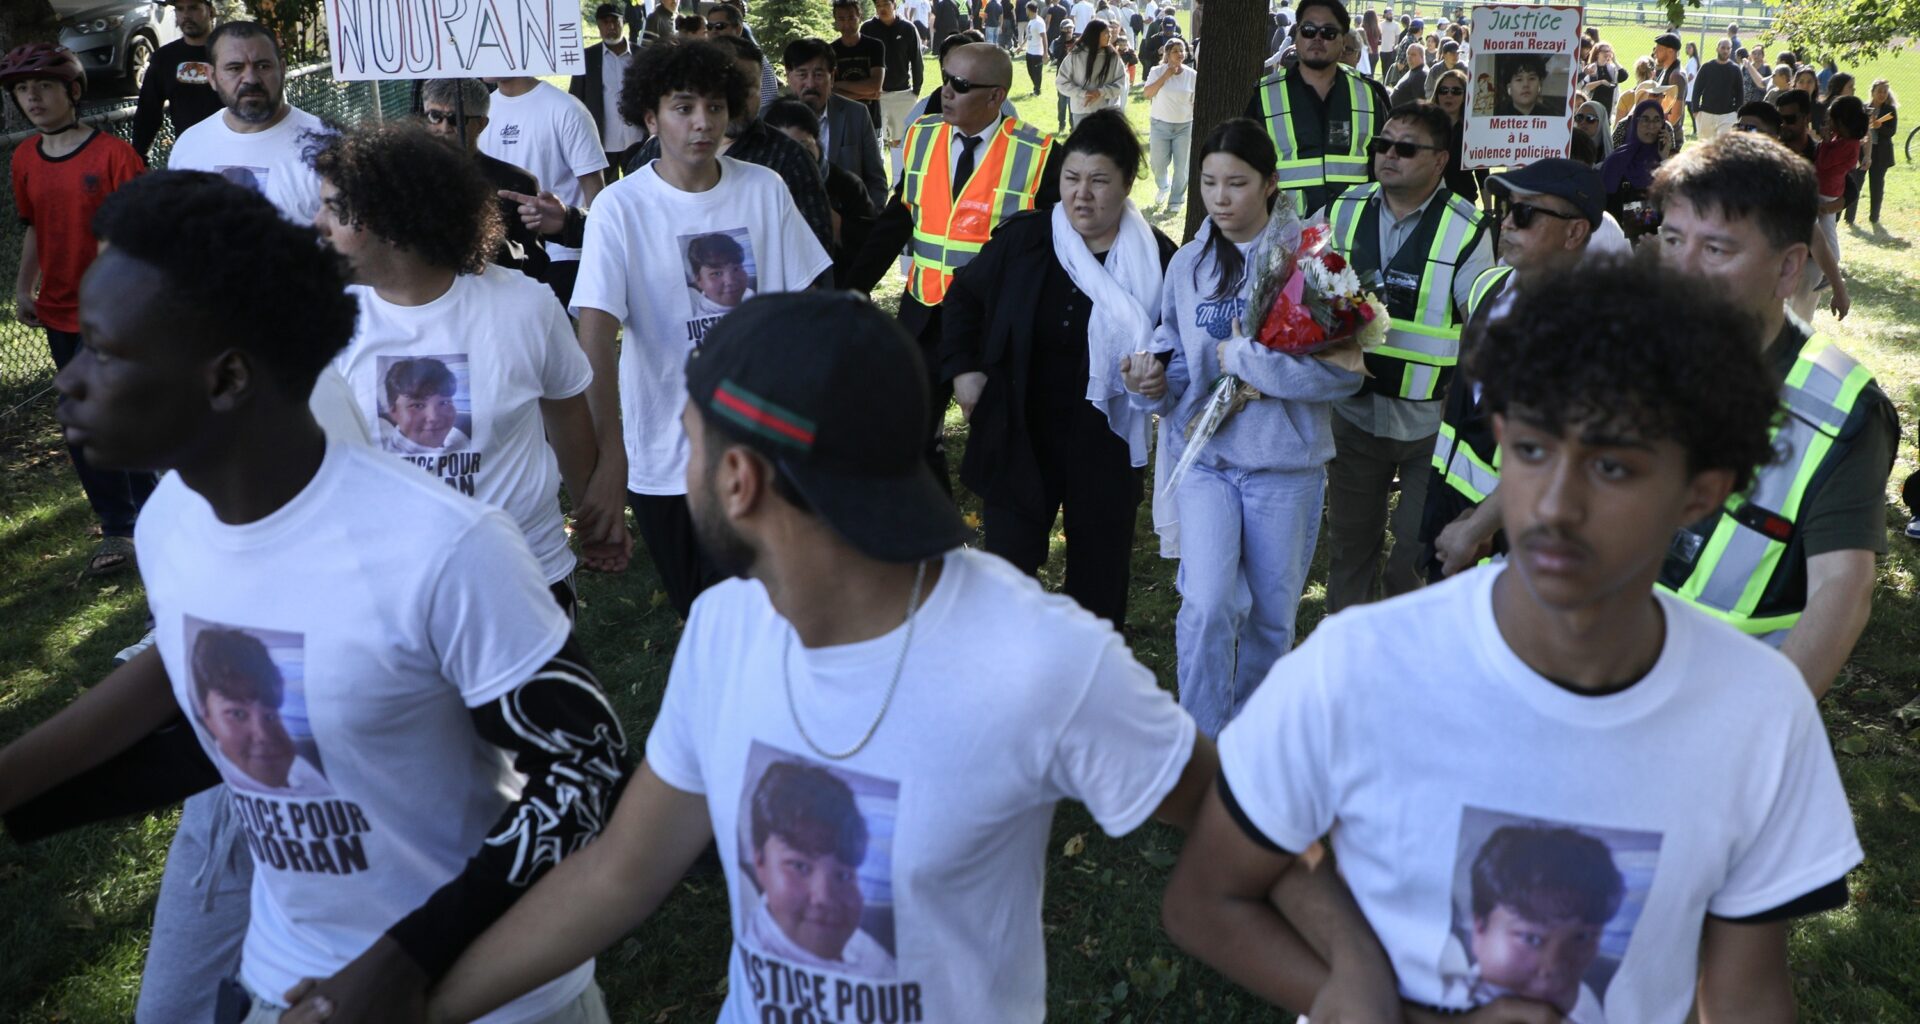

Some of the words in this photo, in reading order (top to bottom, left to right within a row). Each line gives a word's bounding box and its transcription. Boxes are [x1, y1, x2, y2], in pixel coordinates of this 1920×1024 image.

[1488, 11, 1562, 30] Justice
[559, 22, 580, 66] #LLN
[1483, 38, 1523, 50] Nooran
[1528, 38, 1566, 52] Rezayi
[1489, 118, 1528, 129] Mettez
[1532, 118, 1547, 129] fin
[1508, 132, 1515, 143] à
[1519, 132, 1529, 143] la
[1469, 146, 1511, 159] violence
[1515, 145, 1561, 160] policière
[438, 452, 481, 477] POUR
[287, 799, 372, 839] POUR
[835, 978, 923, 1024] POUR
